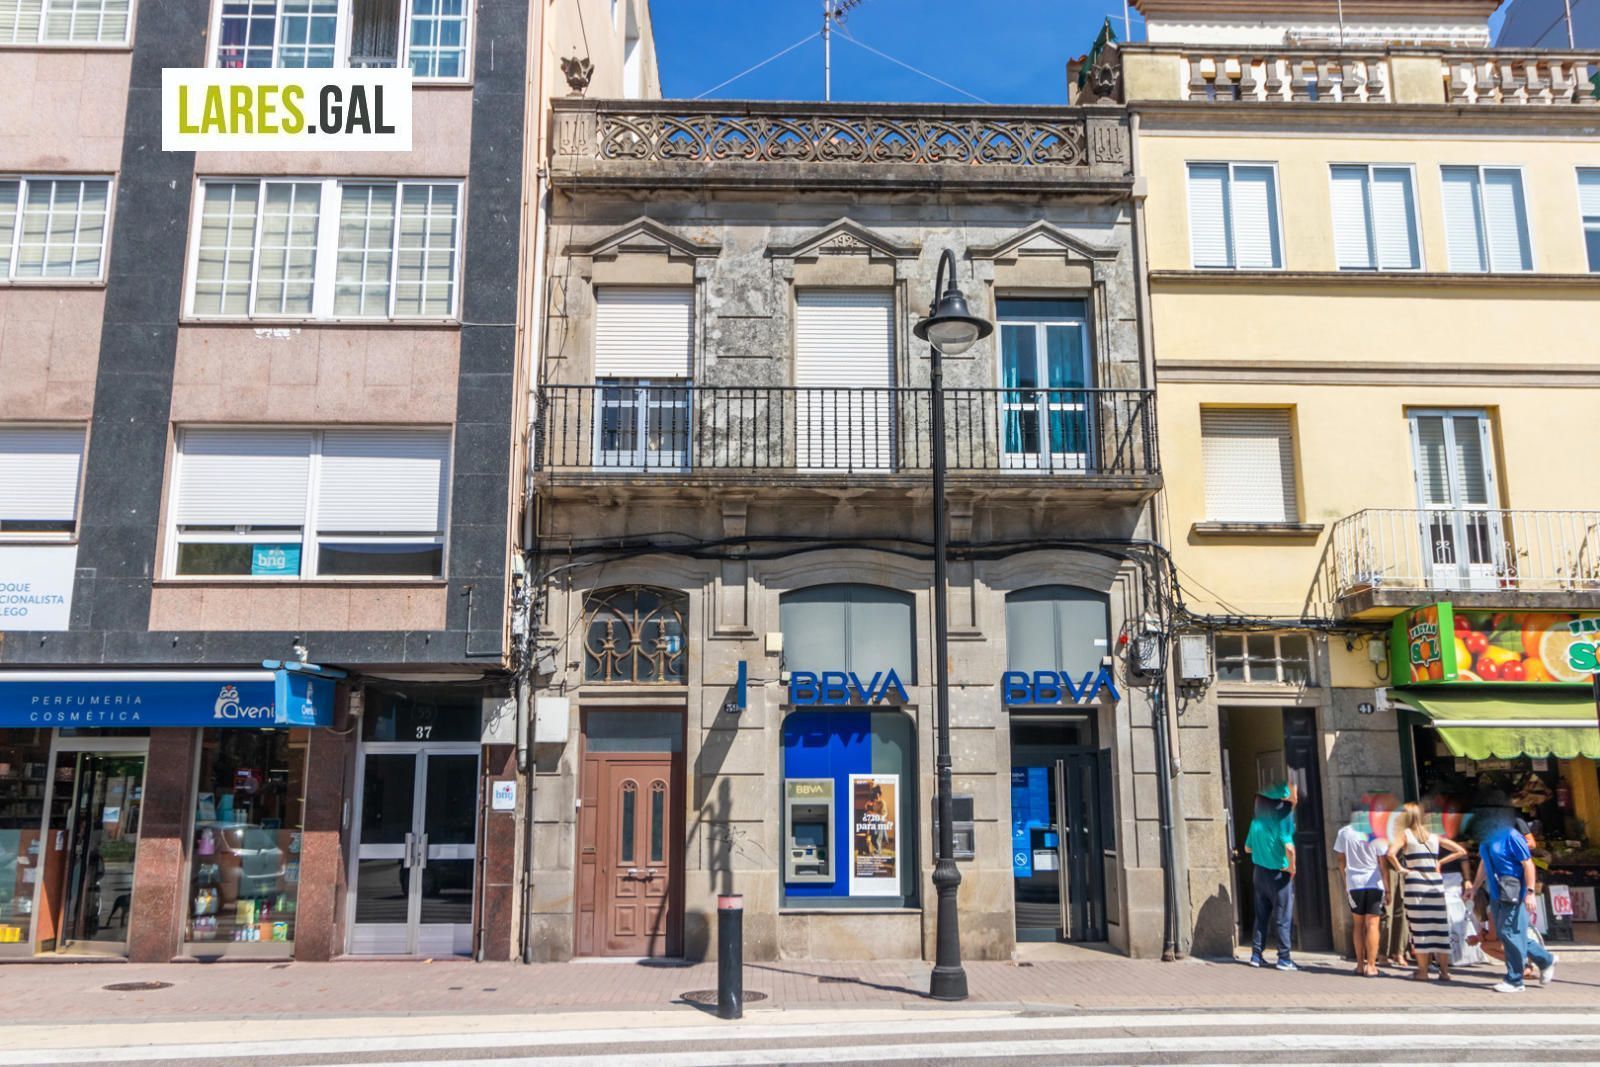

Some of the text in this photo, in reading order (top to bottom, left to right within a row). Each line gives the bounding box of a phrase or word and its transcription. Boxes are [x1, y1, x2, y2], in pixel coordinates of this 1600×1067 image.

[791, 667, 910, 705] BBVA
[1003, 667, 1121, 704] BBVA
[31, 695, 142, 706] PERFUMERÍA
[30, 710, 140, 721] COSMÉTICA
[415, 726, 432, 739] 37
[795, 784, 824, 794] BBVA
[856, 823, 875, 832] para
